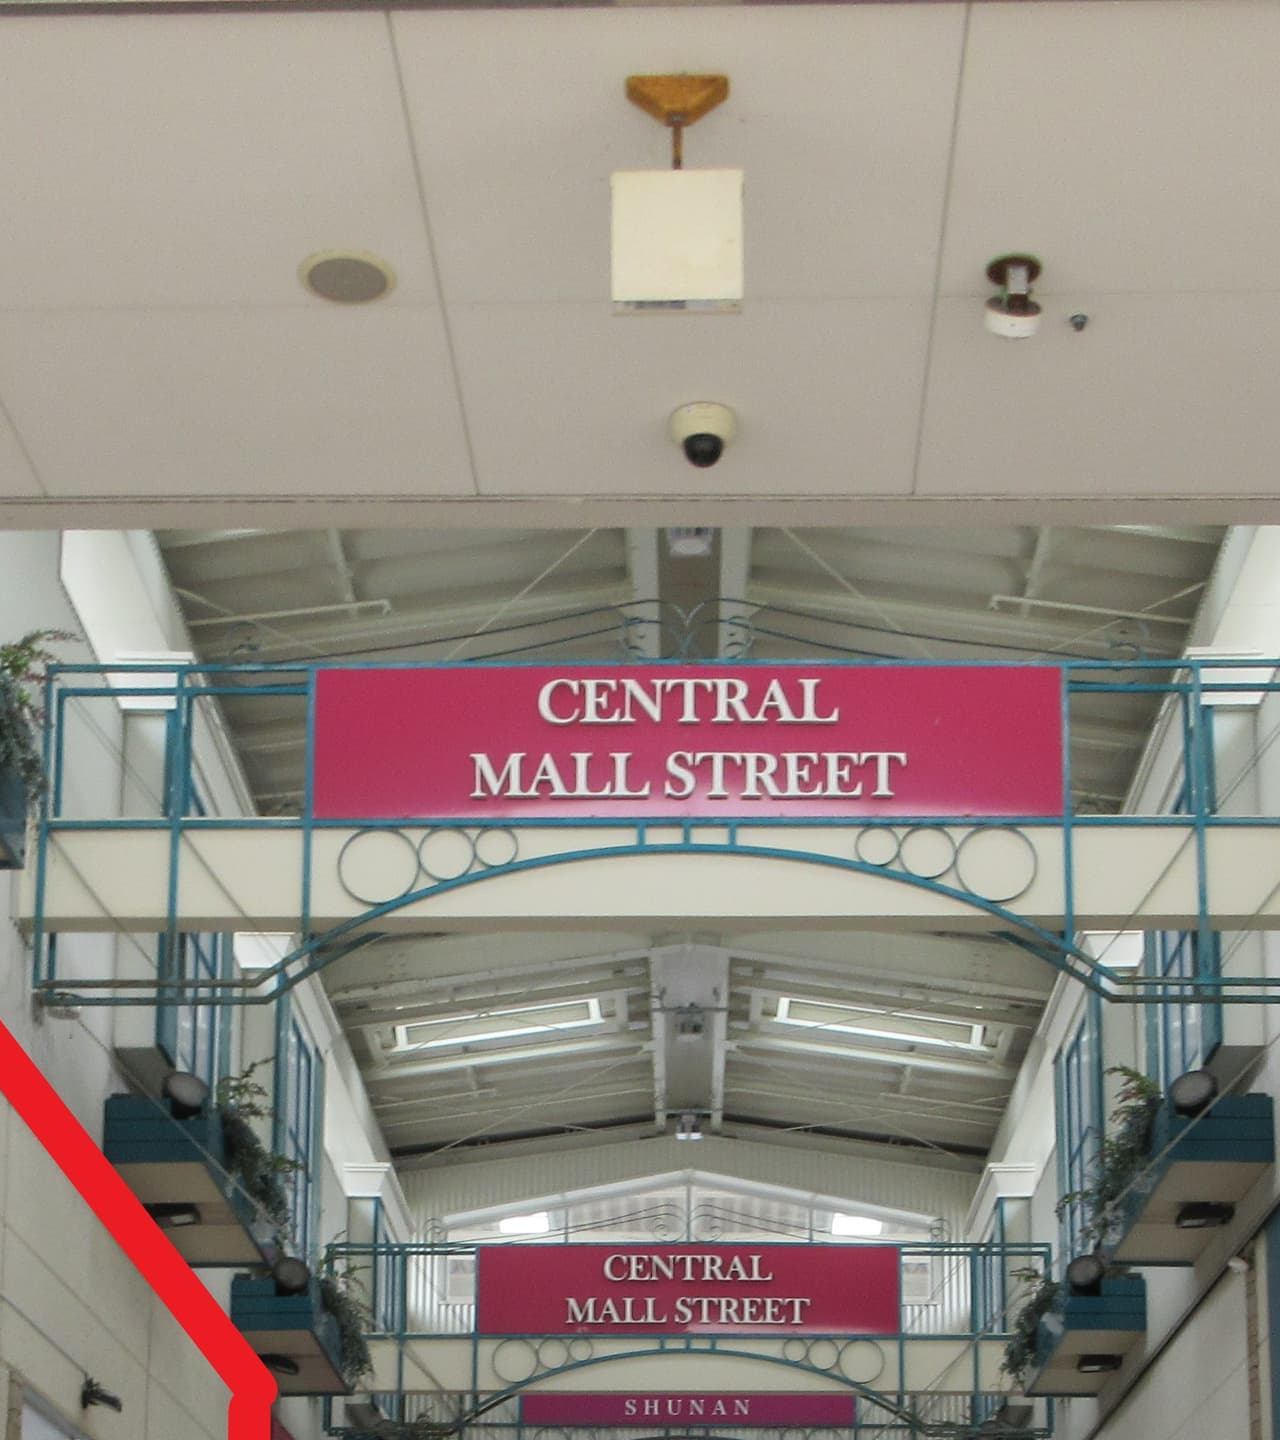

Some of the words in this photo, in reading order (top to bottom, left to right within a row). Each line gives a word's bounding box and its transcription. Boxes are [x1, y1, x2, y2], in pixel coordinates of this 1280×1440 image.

[537, 678, 840, 725] CENTRAL
[469, 752, 651, 799] MALL
[663, 751, 908, 800] STREET
[603, 1254, 773, 1282] CENTRAL
[565, 1297, 668, 1325] MALL
[674, 1296, 811, 1325] STREET
[624, 1399, 750, 1416] SHUNAN
